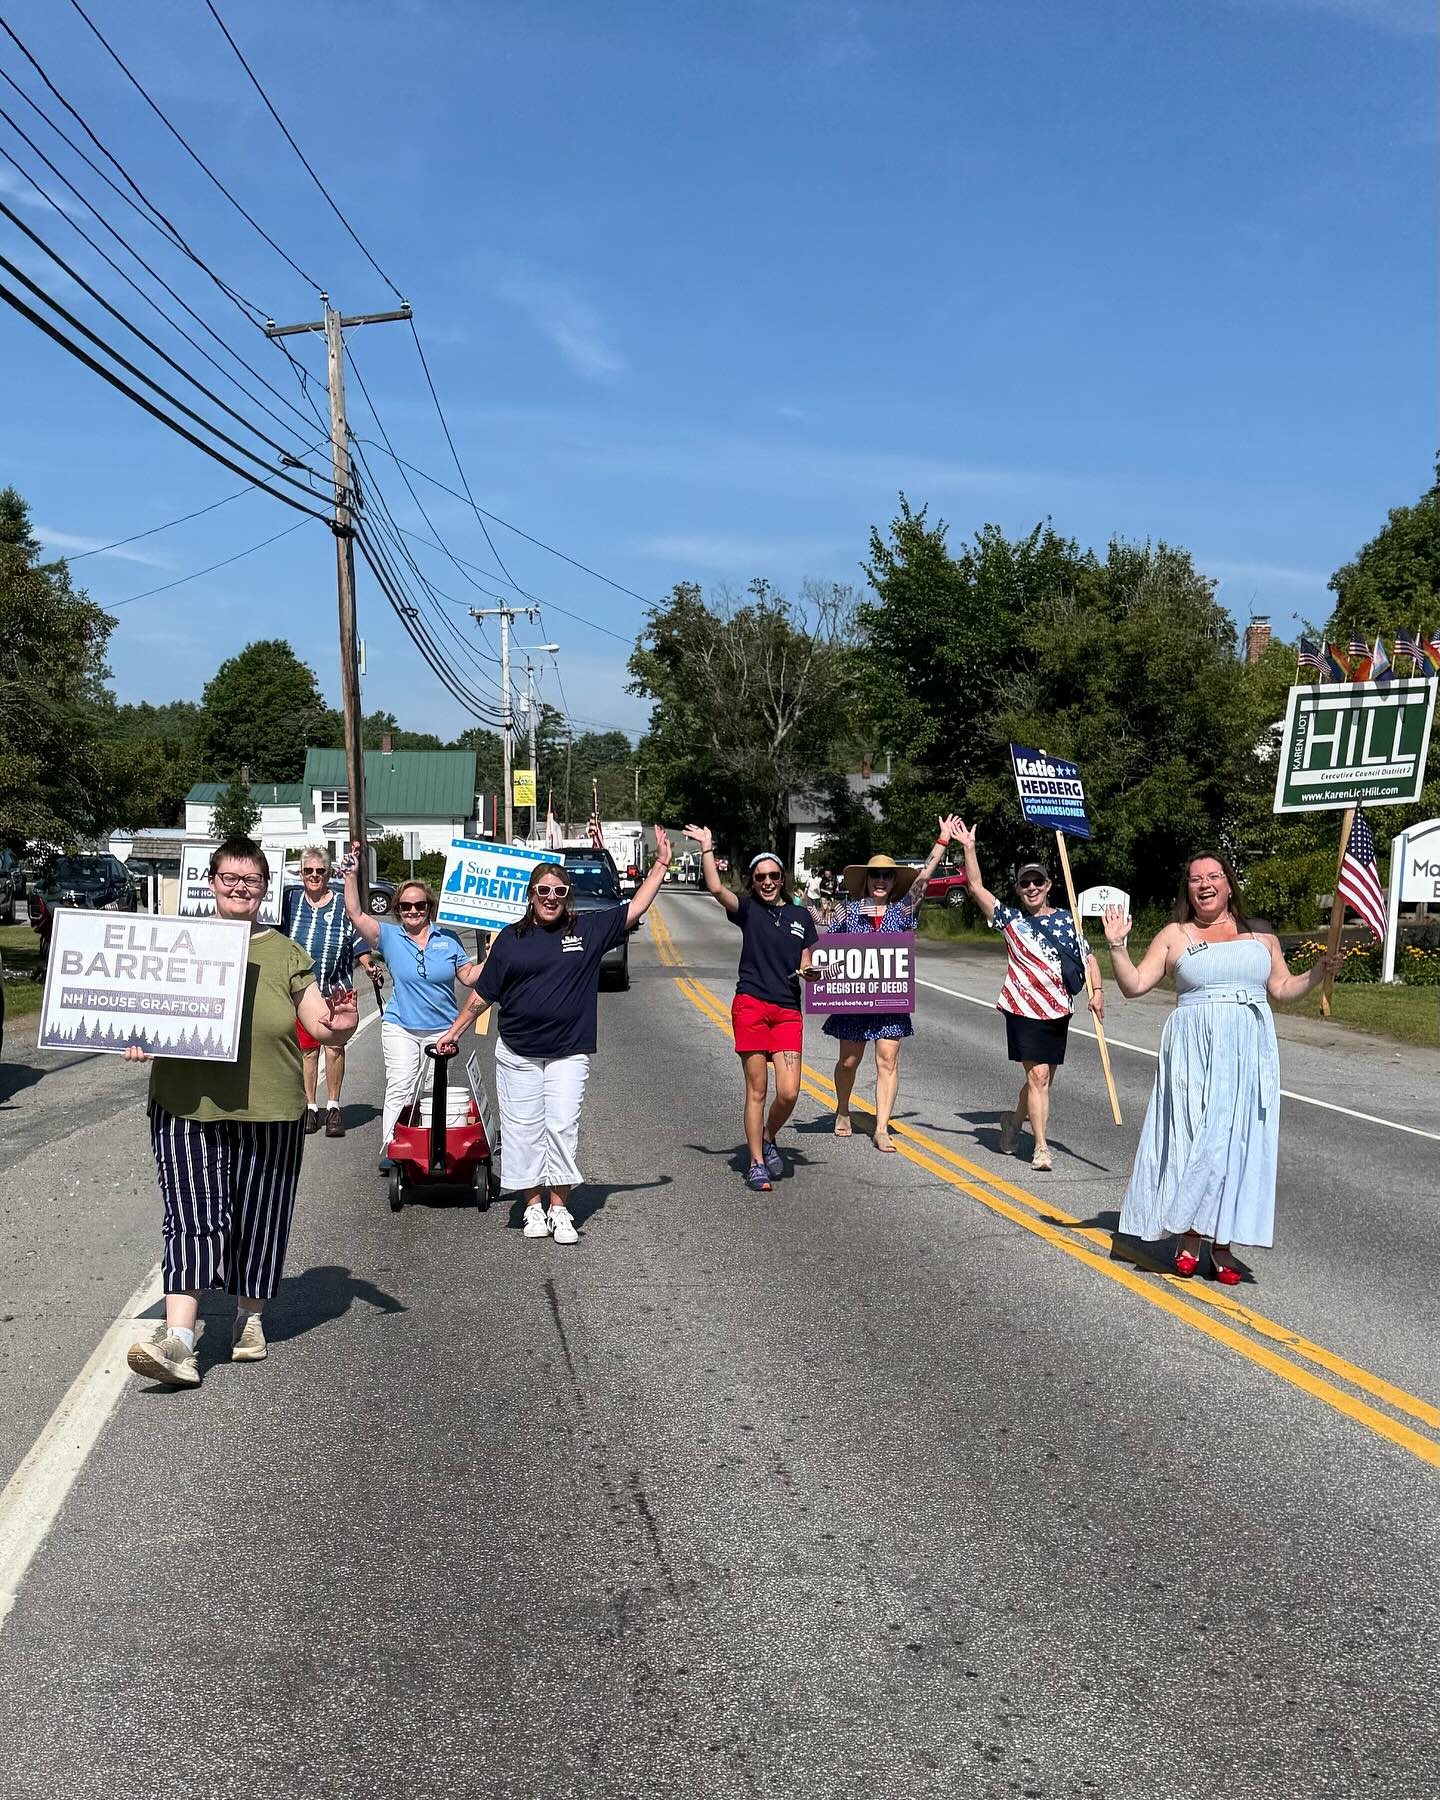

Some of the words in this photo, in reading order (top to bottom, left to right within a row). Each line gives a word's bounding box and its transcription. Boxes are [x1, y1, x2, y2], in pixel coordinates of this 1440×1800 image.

[1302, 706, 1417, 769] HILL
[1292, 738, 1304, 770] KAREN
[1015, 758, 1056, 778] Katie
[1321, 772, 1353, 780] Executive
[1355, 769, 1380, 777] Council
[1381, 766, 1406, 776] District
[1020, 780, 1082, 797] HEDBERG
[1026, 804, 1085, 818] COMMISSIONER
[1061, 799, 1083, 807] COUNTY
[467, 861, 491, 876] Sue
[463, 874, 529, 903] PRENTI
[103, 923, 196, 955] ELLA
[60, 950, 235, 986] BARRETT
[813, 983, 825, 995] for
[826, 982, 866, 994] REGISTER
[868, 982, 879, 993] OF
[881, 981, 908, 993] DEEDS
[63, 993, 83, 1005] NH
[87, 995, 137, 1008] HOUSE
[141, 999, 210, 1013] GRAFTON
[214, 1005, 223, 1014] 9
